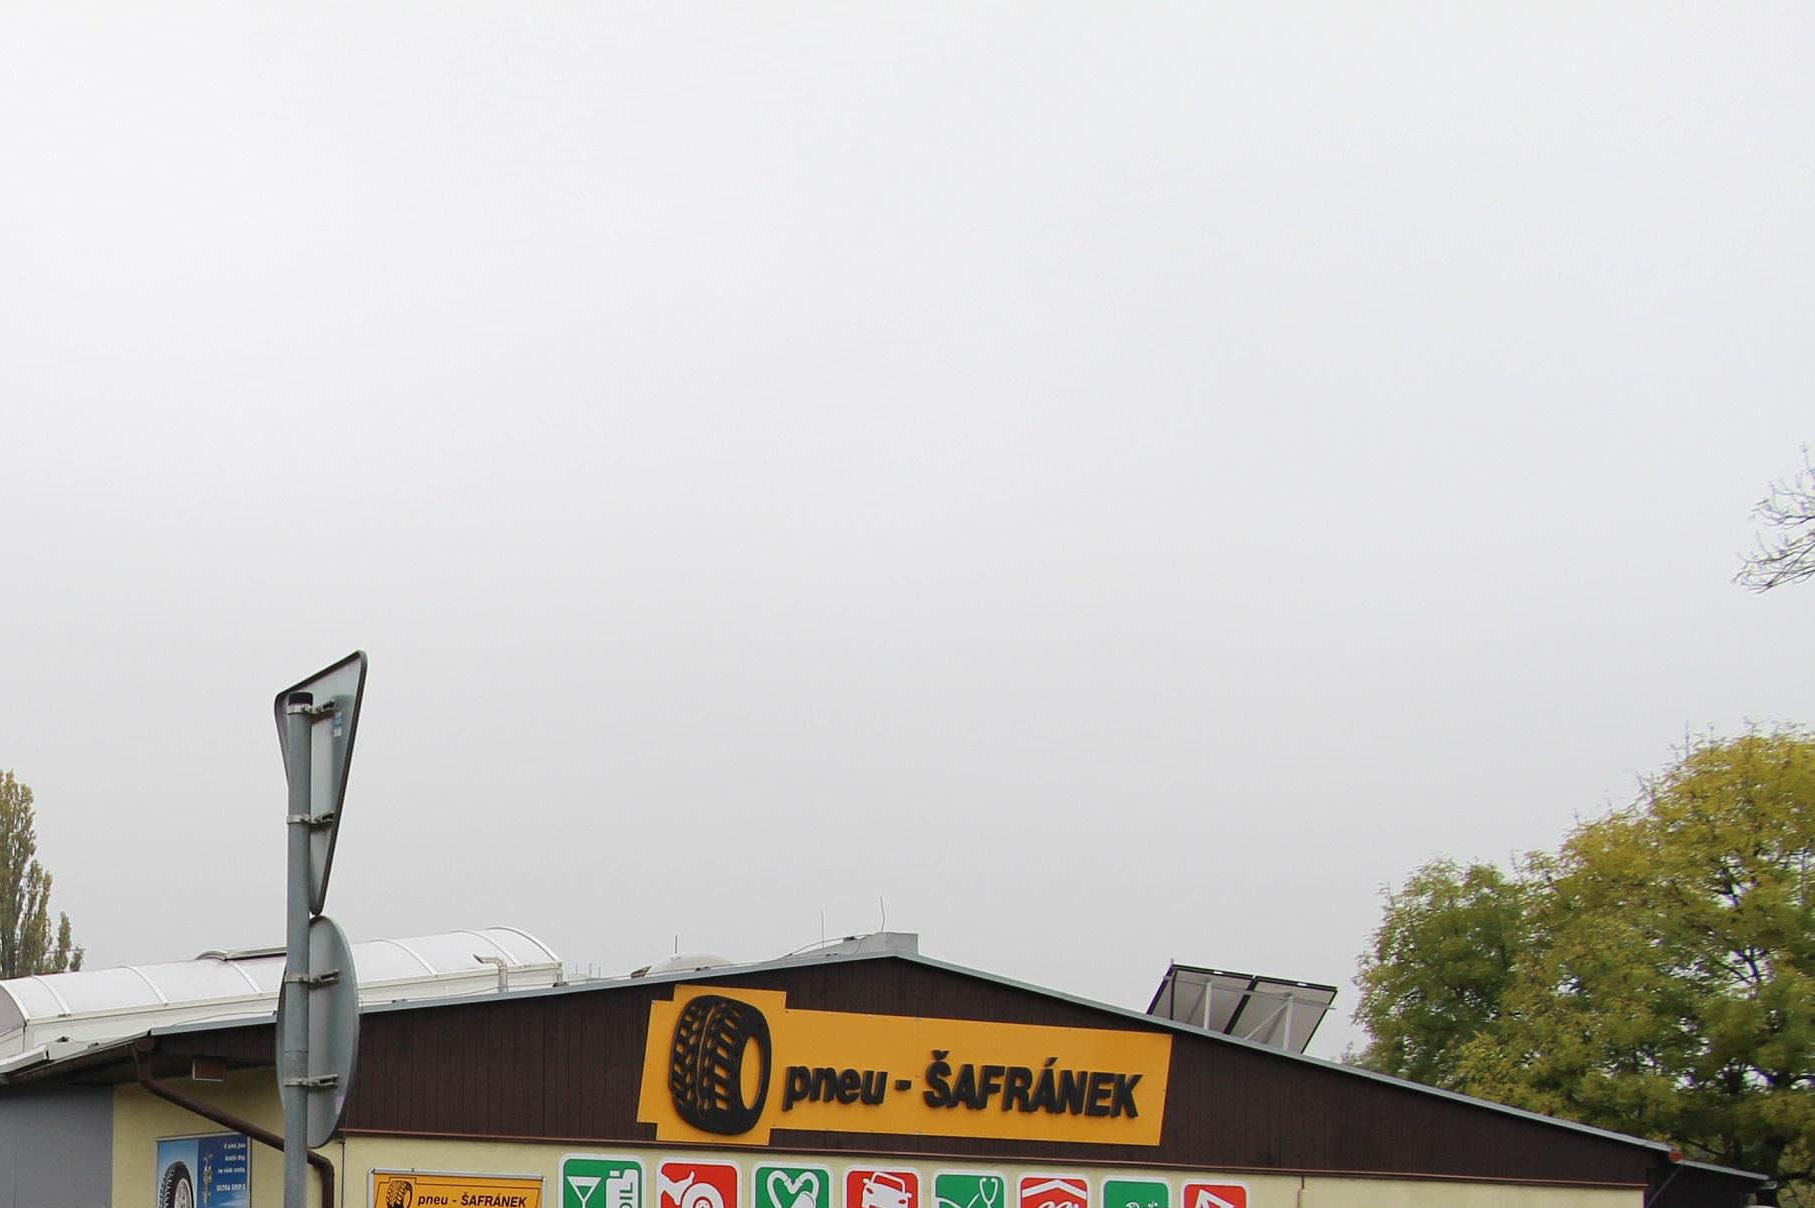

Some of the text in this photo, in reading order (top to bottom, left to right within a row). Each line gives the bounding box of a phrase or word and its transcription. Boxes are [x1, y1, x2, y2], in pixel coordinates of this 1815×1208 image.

[782, 1065, 888, 1112] pneu
[922, 1050, 1143, 1118] ŠAFRÁNEK
[418, 1194, 448, 1207] pneu
[461, 1192, 527, 1208] ŠAFRÁNEK
